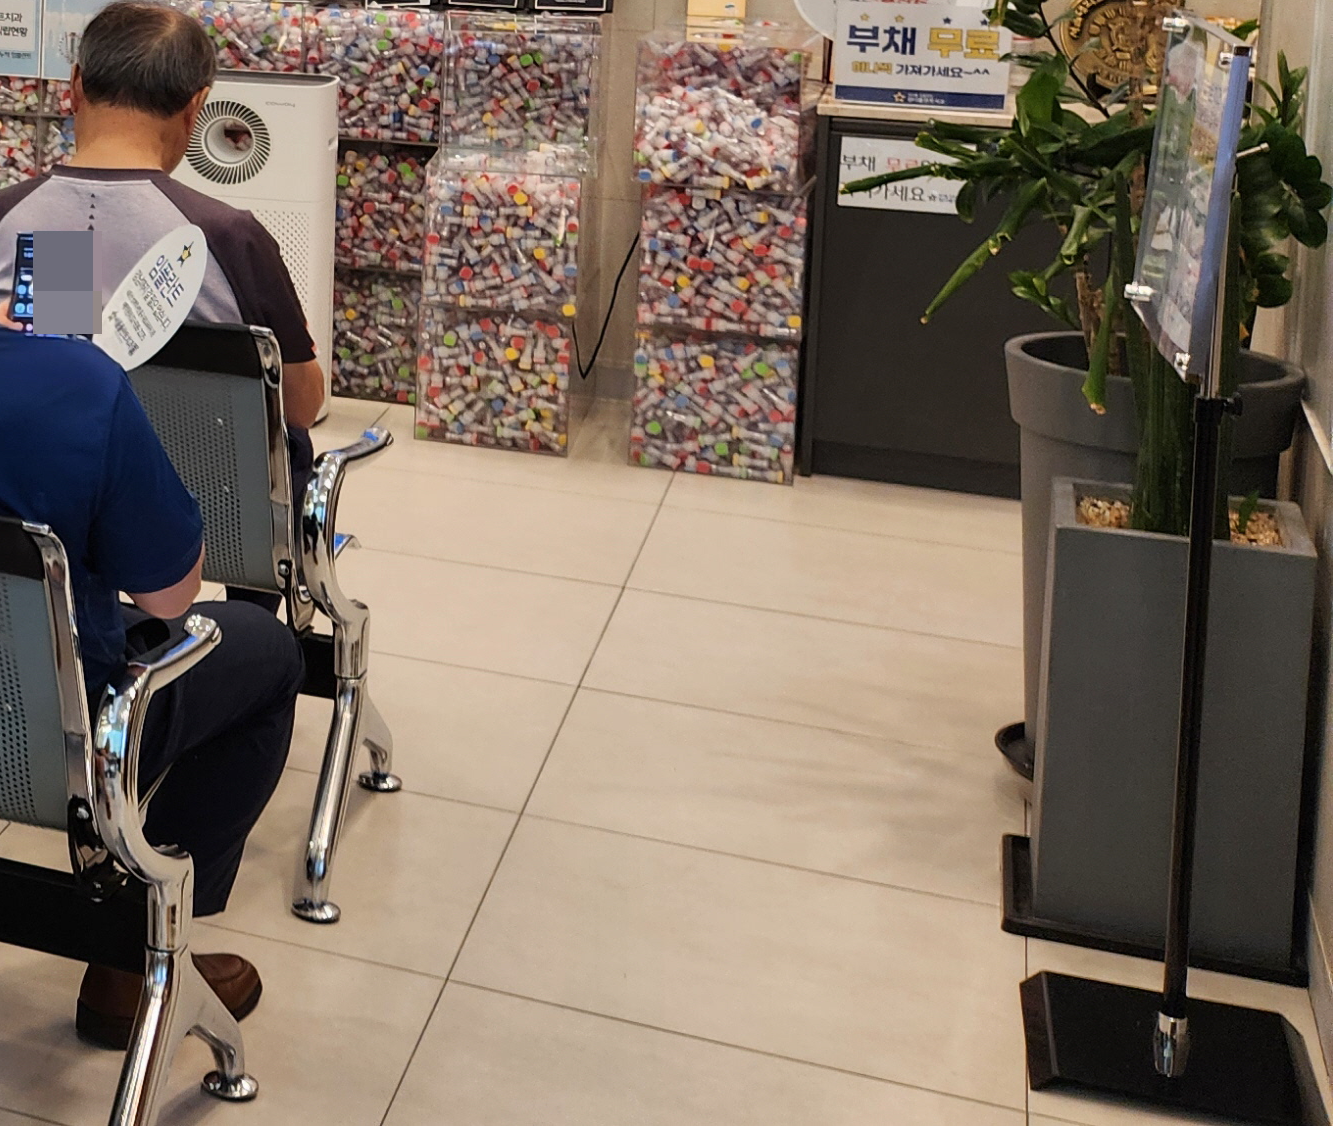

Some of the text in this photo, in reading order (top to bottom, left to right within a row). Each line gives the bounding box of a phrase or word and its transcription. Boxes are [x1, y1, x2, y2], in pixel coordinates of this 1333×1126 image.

[847, 25, 1000, 60] 부채 무료
[149, 254, 185, 308] 임플란트
